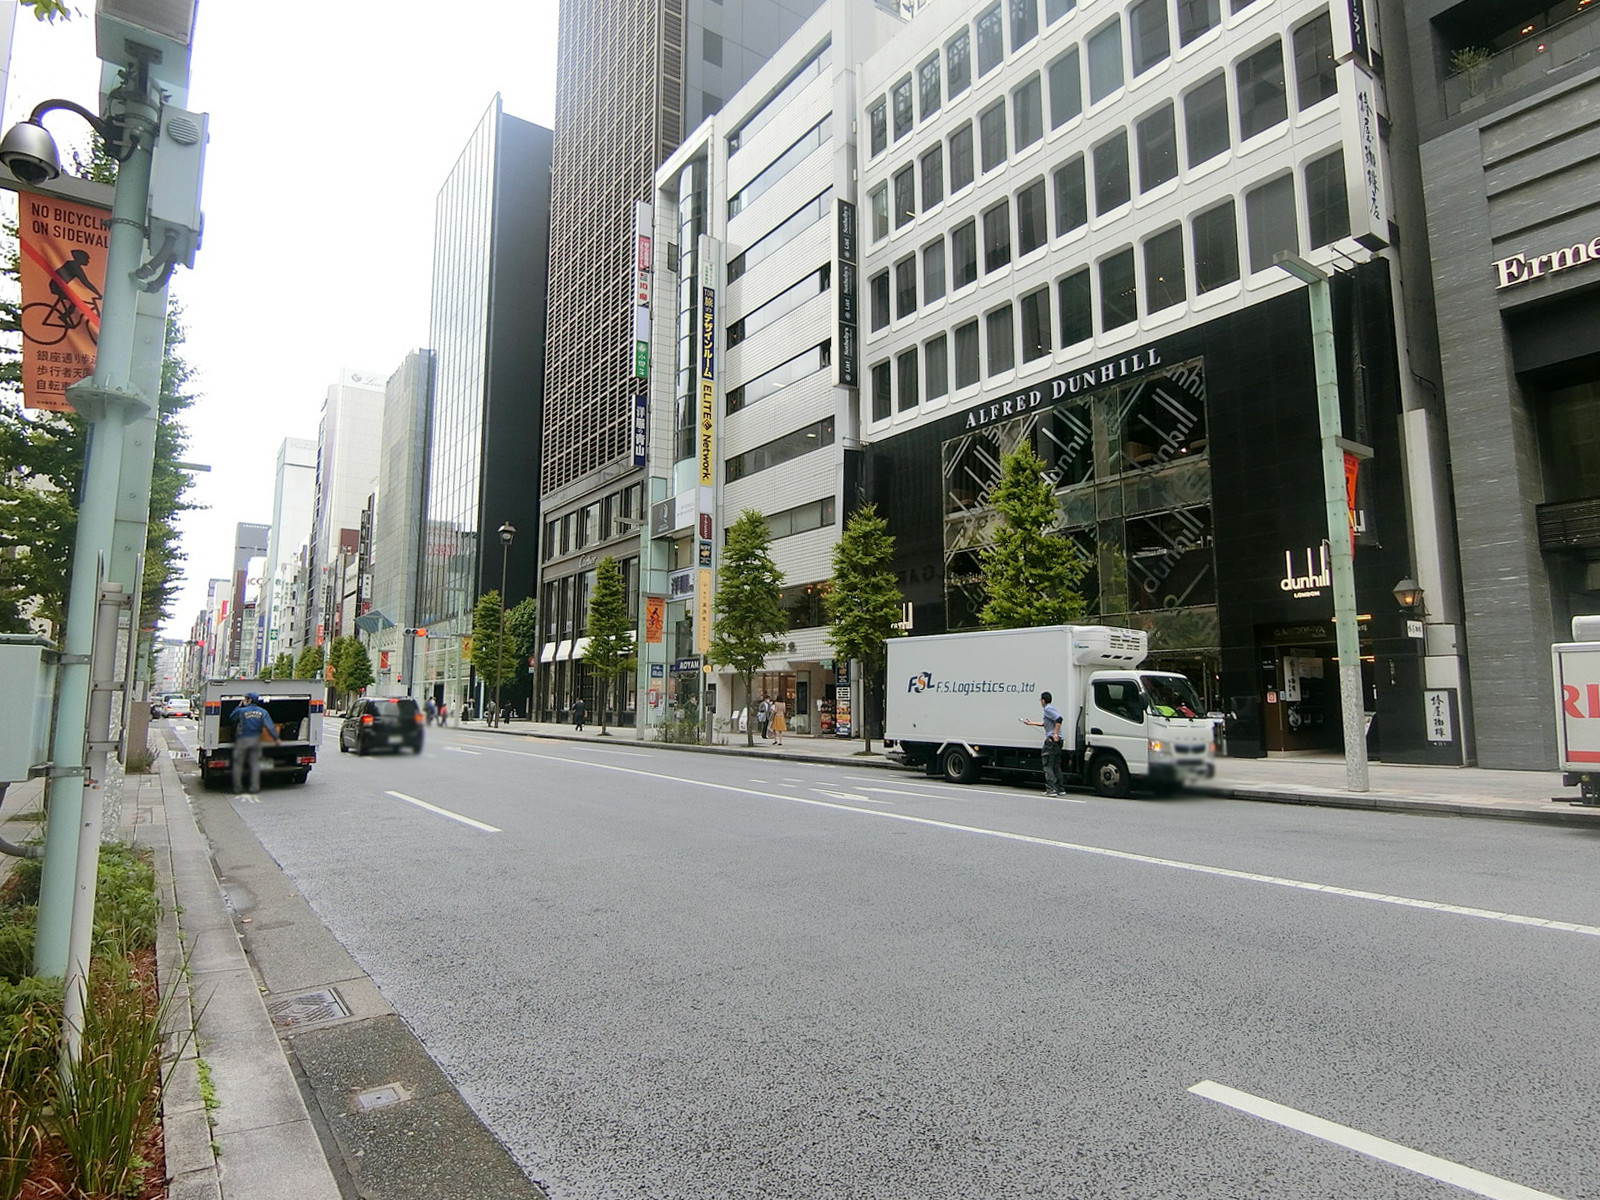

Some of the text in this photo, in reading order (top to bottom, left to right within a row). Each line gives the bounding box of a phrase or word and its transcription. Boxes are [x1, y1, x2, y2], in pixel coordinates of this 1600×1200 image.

[32, 202, 49, 219] NO
[32, 220, 49, 236] ON
[965, 390, 1042, 429] ALFRED
[1051, 348, 1162, 400] DUNHILL
[703, 384, 712, 420] ELITE
